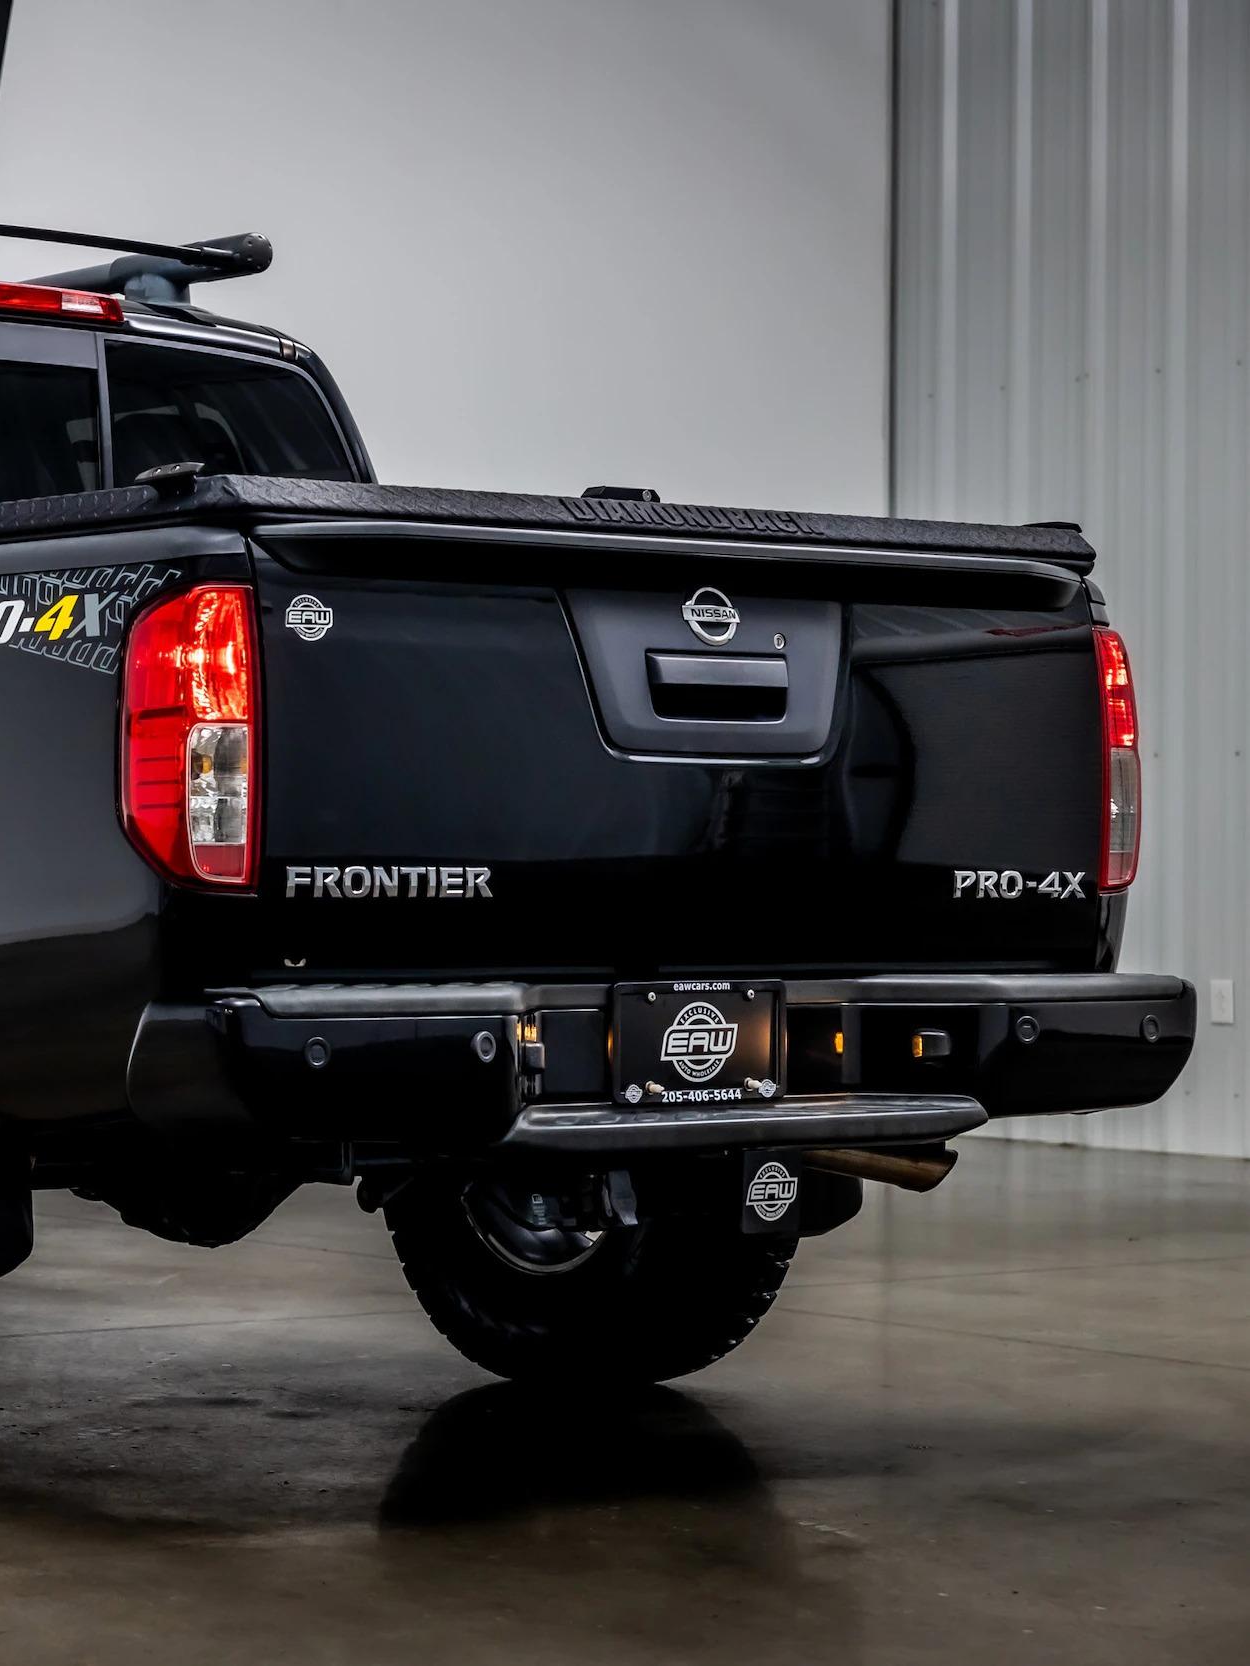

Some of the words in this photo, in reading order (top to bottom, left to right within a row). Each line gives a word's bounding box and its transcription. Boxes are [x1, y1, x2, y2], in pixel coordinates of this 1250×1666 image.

[558, 498, 824, 535] DIAMONDBACK
[288, 610, 330, 624] EAW
[691, 608, 736, 619] NISSAN
[285, 866, 493, 898] FRONTIER
[952, 870, 1087, 899] PRO-4X
[673, 982, 730, 991] eawcars.com
[680, 1007, 720, 1024] EXCLUSIVE
[667, 1031, 732, 1054] EAW
[678, 1061, 692, 1074] AUTO
[661, 1088, 742, 1102] 205-406-5644
[750, 1182, 795, 1200] EAW
